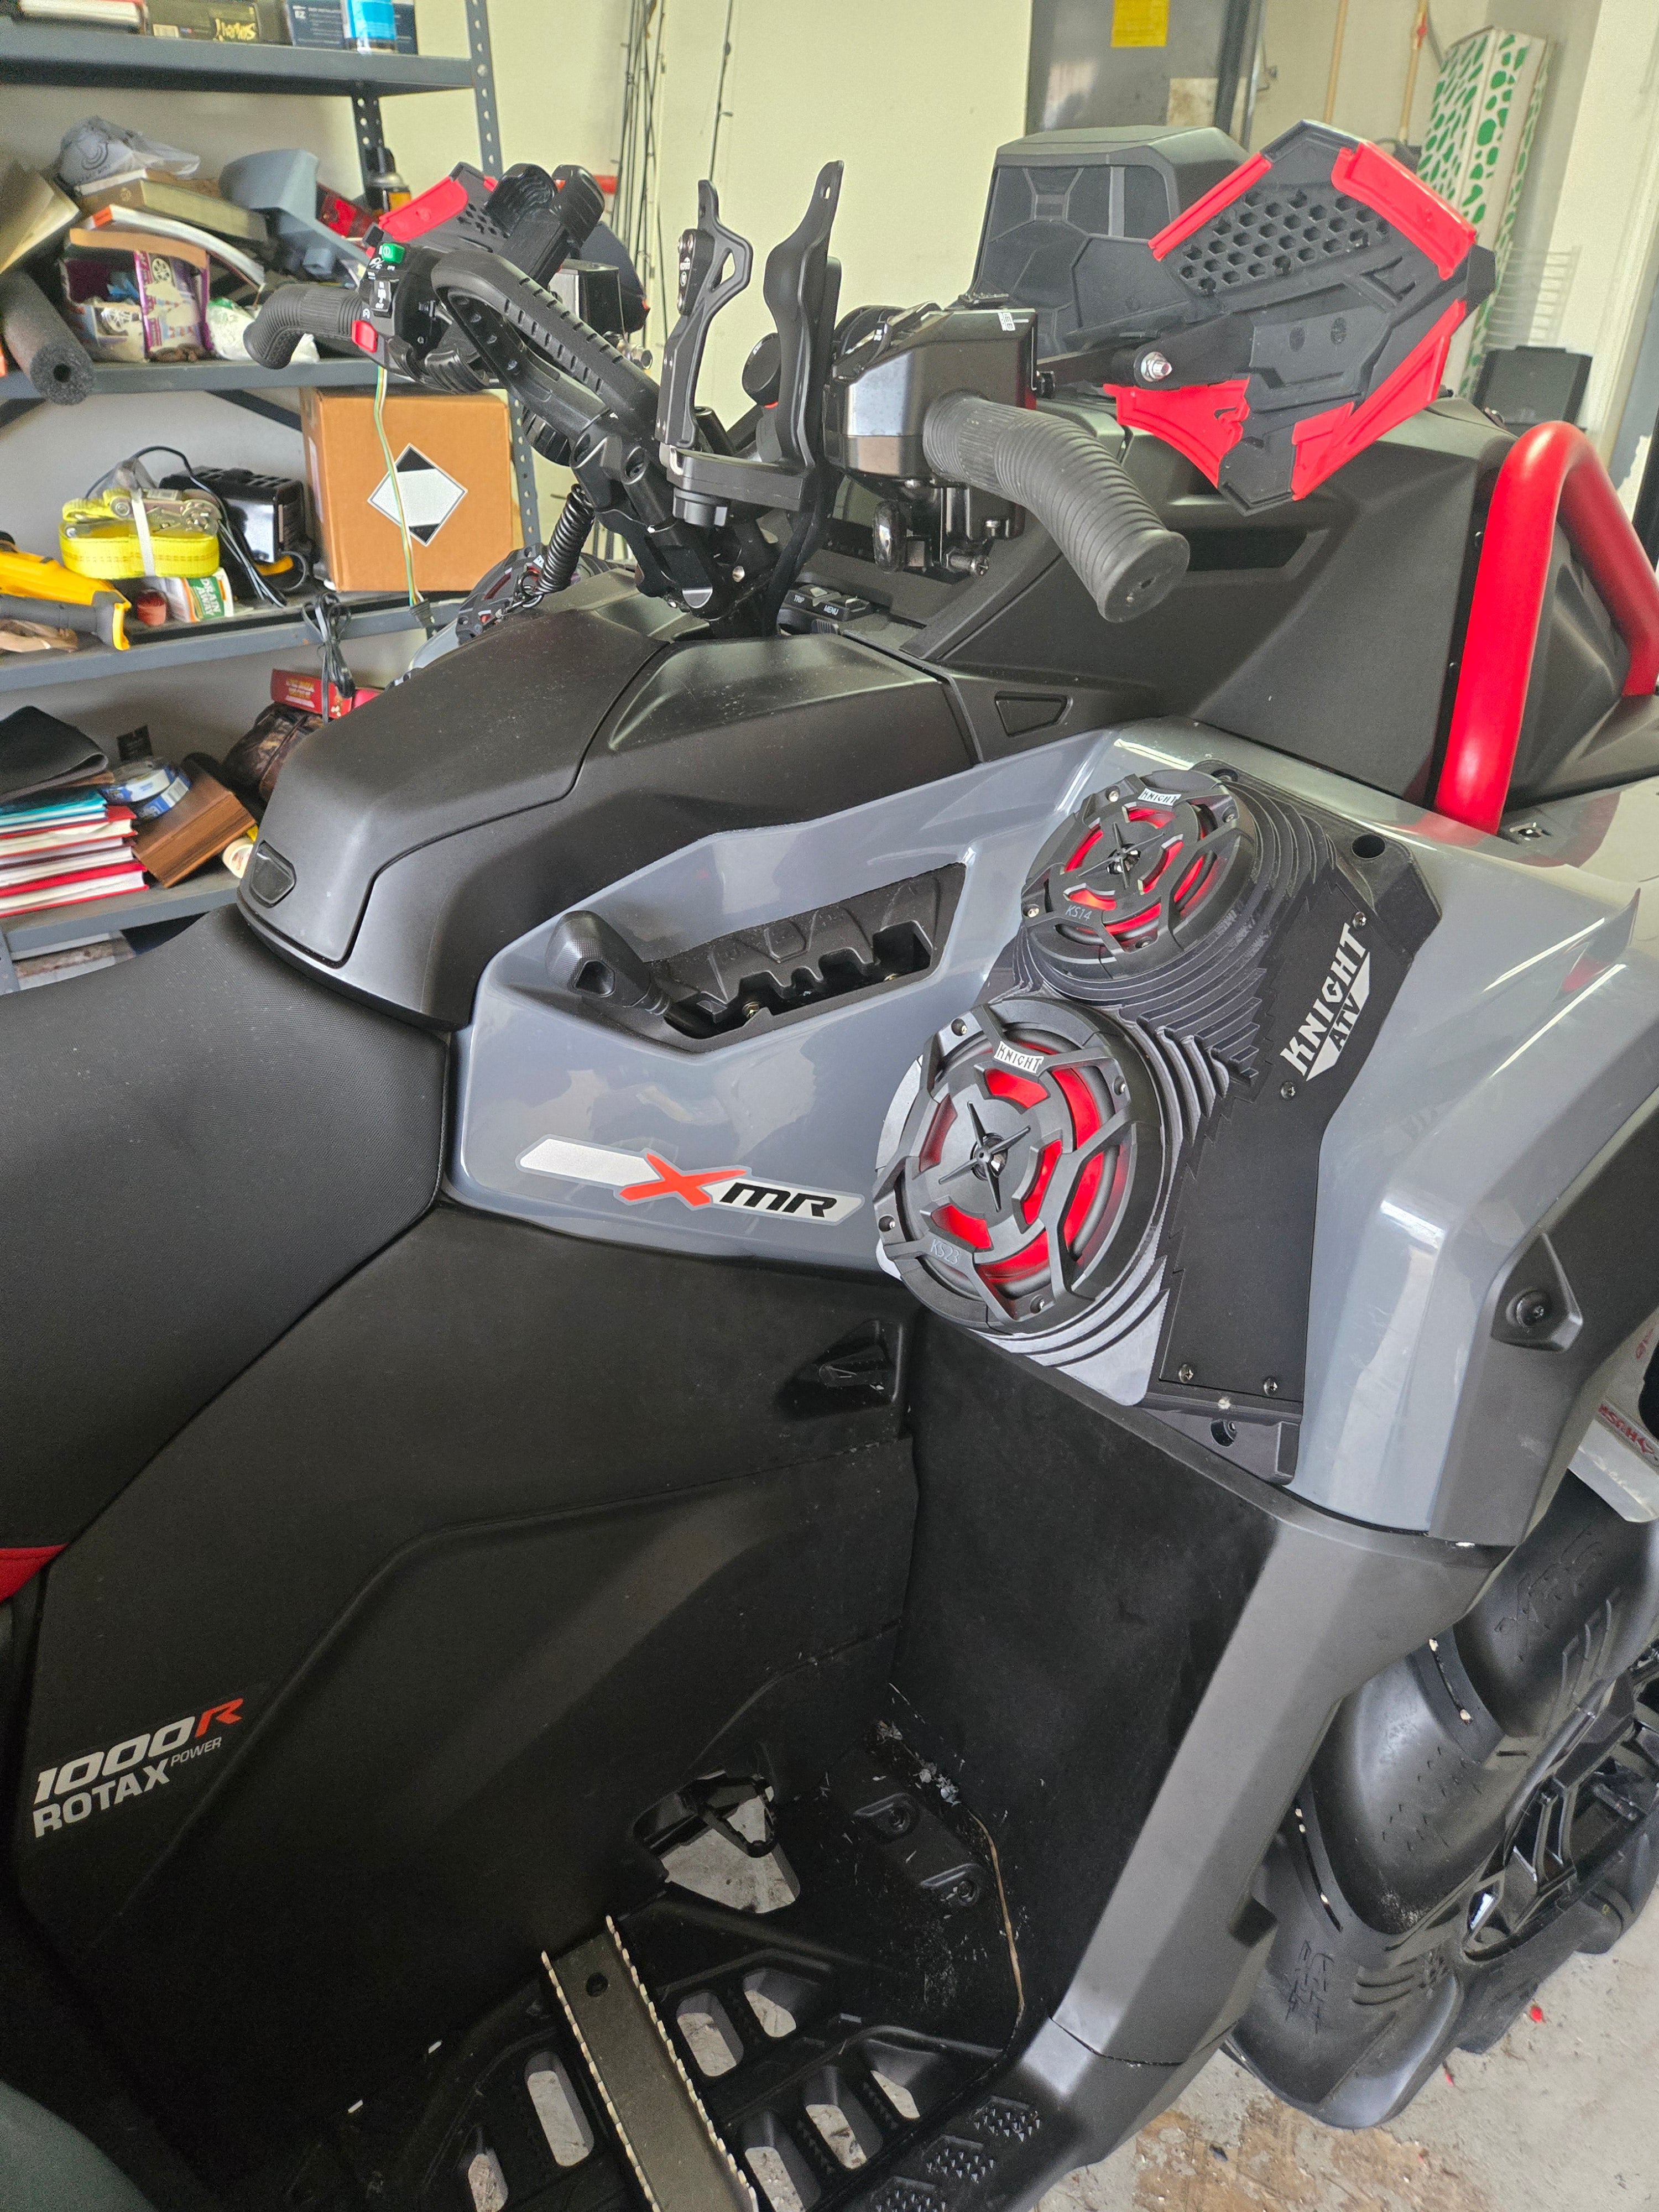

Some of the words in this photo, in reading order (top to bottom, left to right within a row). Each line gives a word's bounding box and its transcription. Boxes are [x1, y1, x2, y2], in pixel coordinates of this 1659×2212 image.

[794, 594, 805, 603] TRIP
[823, 605, 839, 615] MENU
[1140, 790, 1178, 805] KNIGHT
[1065, 905, 1093, 921] KS14
[1280, 922, 1366, 1076] KNIGHT
[1328, 992, 1360, 1052] ATV
[998, 1044, 1043, 1073] KNIGHT
[930, 1238, 961, 1265] KS23
[33, 1698, 244, 1805] 1000R
[33, 1759, 170, 1838] ROTAX
[170, 1736, 222, 1767] POWER
